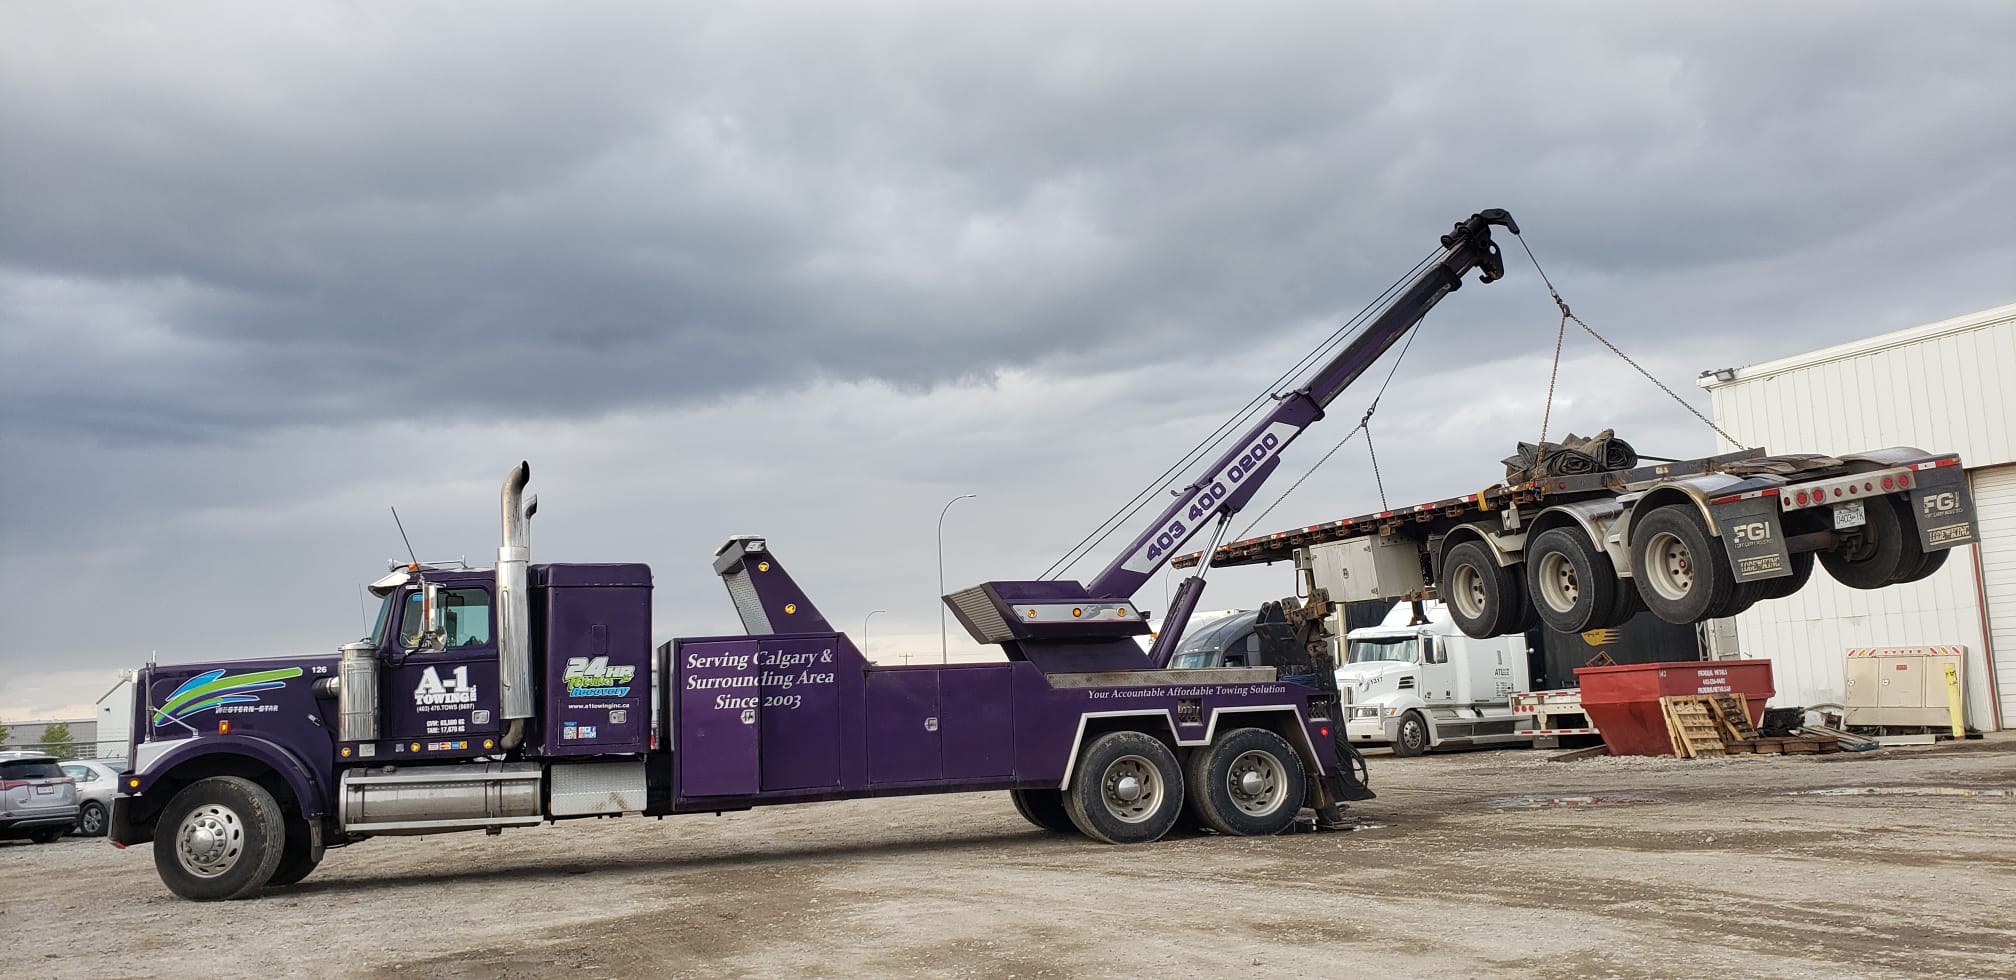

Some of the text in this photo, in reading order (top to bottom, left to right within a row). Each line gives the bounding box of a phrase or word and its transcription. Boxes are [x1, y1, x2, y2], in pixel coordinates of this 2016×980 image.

[1146, 432, 1279, 561] 403 400 0200
[1923, 491, 1960, 513] FGI
[1733, 521, 1770, 543] FGI
[686, 649, 833, 670] Serving Calgary &
[312, 666, 327, 674] 126
[415, 665, 470, 694] A-1
[686, 670, 835, 690] Surrounding Area
[415, 692, 469, 705] TOWING
[714, 693, 802, 709] Since 2003
[1088, 684, 1286, 699] Your Accountable Affordable Towing Solution
